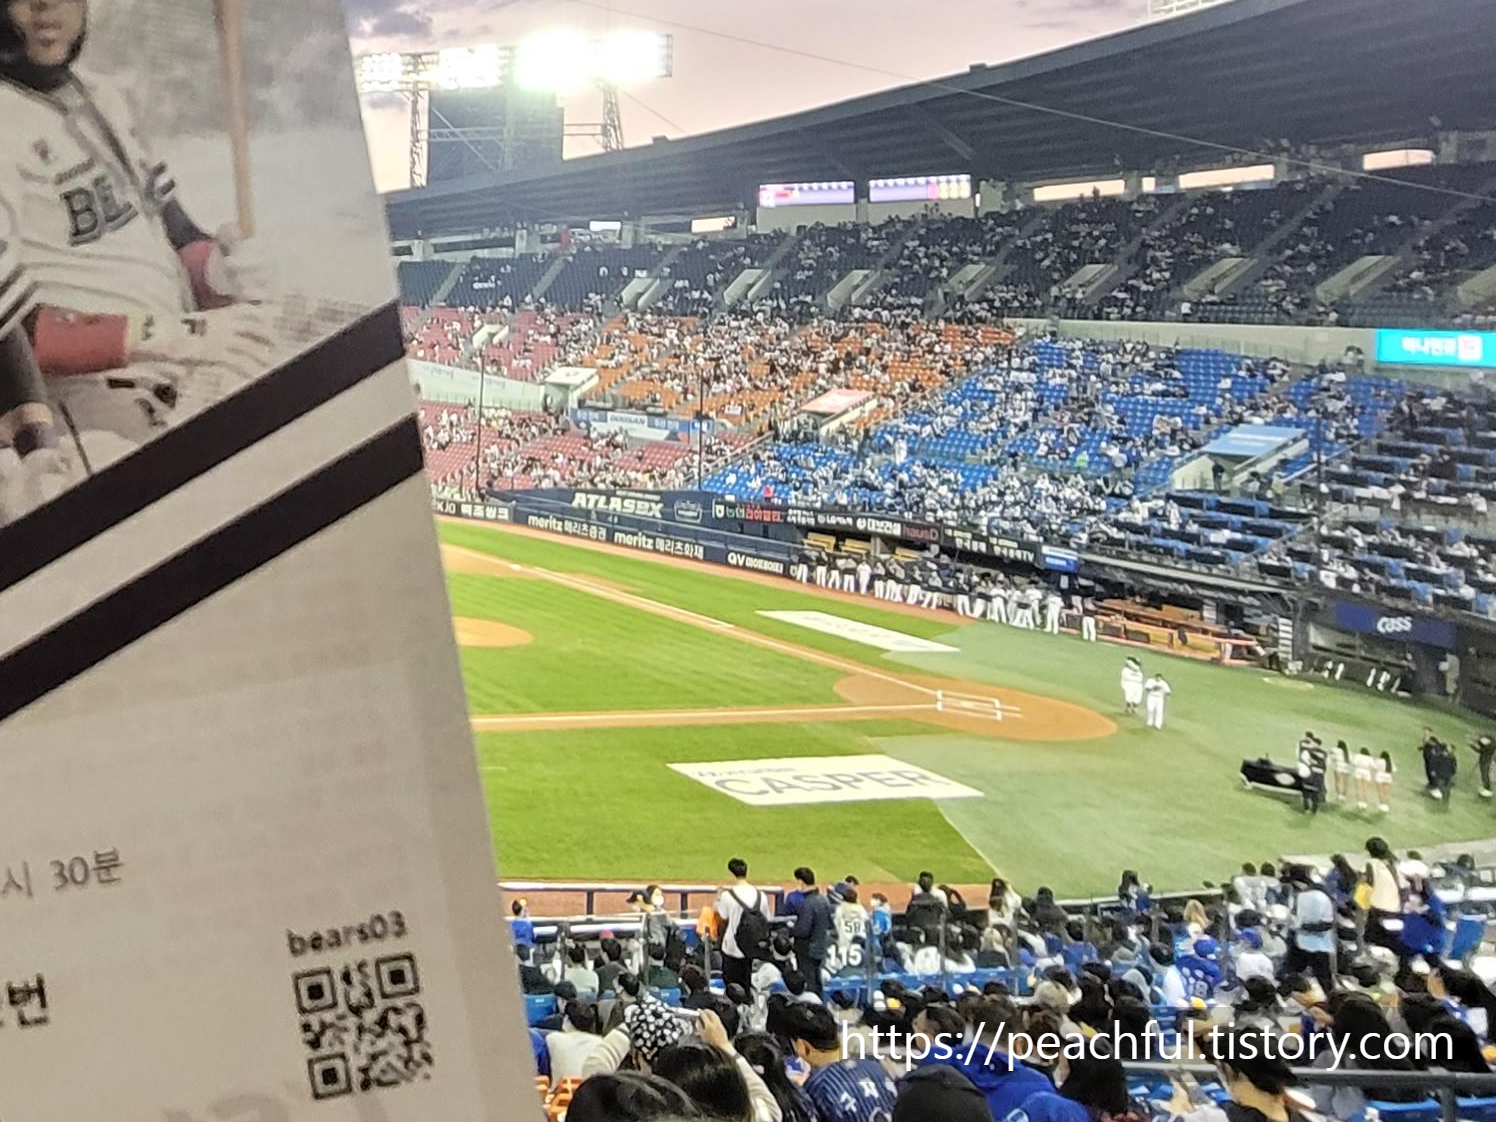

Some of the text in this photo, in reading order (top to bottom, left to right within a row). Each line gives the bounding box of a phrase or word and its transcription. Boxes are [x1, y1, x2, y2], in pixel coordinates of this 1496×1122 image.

[571, 492, 664, 518] ATLASBX
[528, 515, 563, 532] meritz
[614, 531, 654, 549] meritz
[714, 769, 952, 796] CASPER
[49, 846, 126, 892] 30분
[286, 909, 408, 957] bears03
